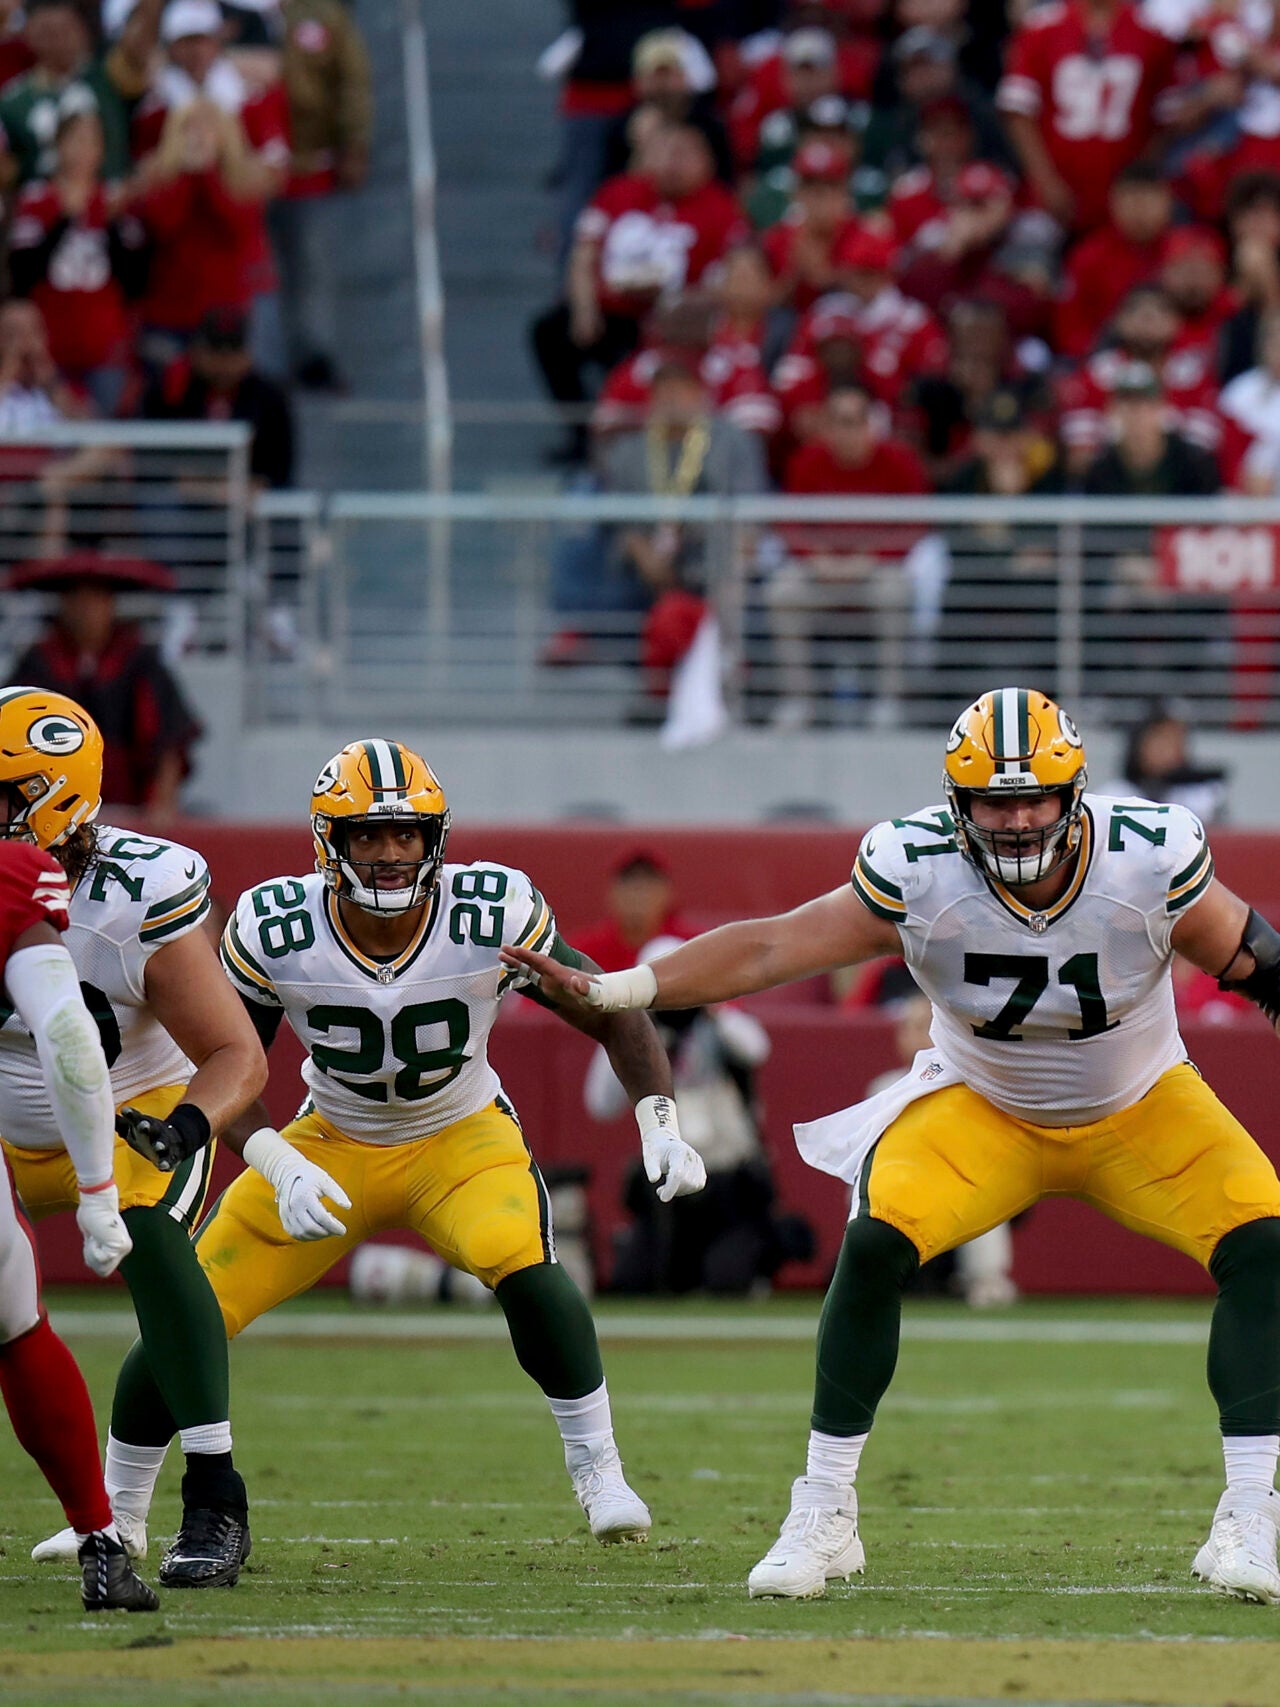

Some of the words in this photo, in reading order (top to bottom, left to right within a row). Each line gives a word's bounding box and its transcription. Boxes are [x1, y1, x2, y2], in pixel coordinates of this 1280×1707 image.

[1052, 53, 1143, 141] 97
[1000, 777, 1026, 785] PACKERS
[891, 811, 960, 862] 71
[1109, 804, 1170, 852] 71
[89, 837, 170, 902] 70
[251, 880, 316, 959] 28
[449, 870, 508, 948] 28
[964, 952, 1121, 1041] 71
[306, 998, 472, 1103] 28
